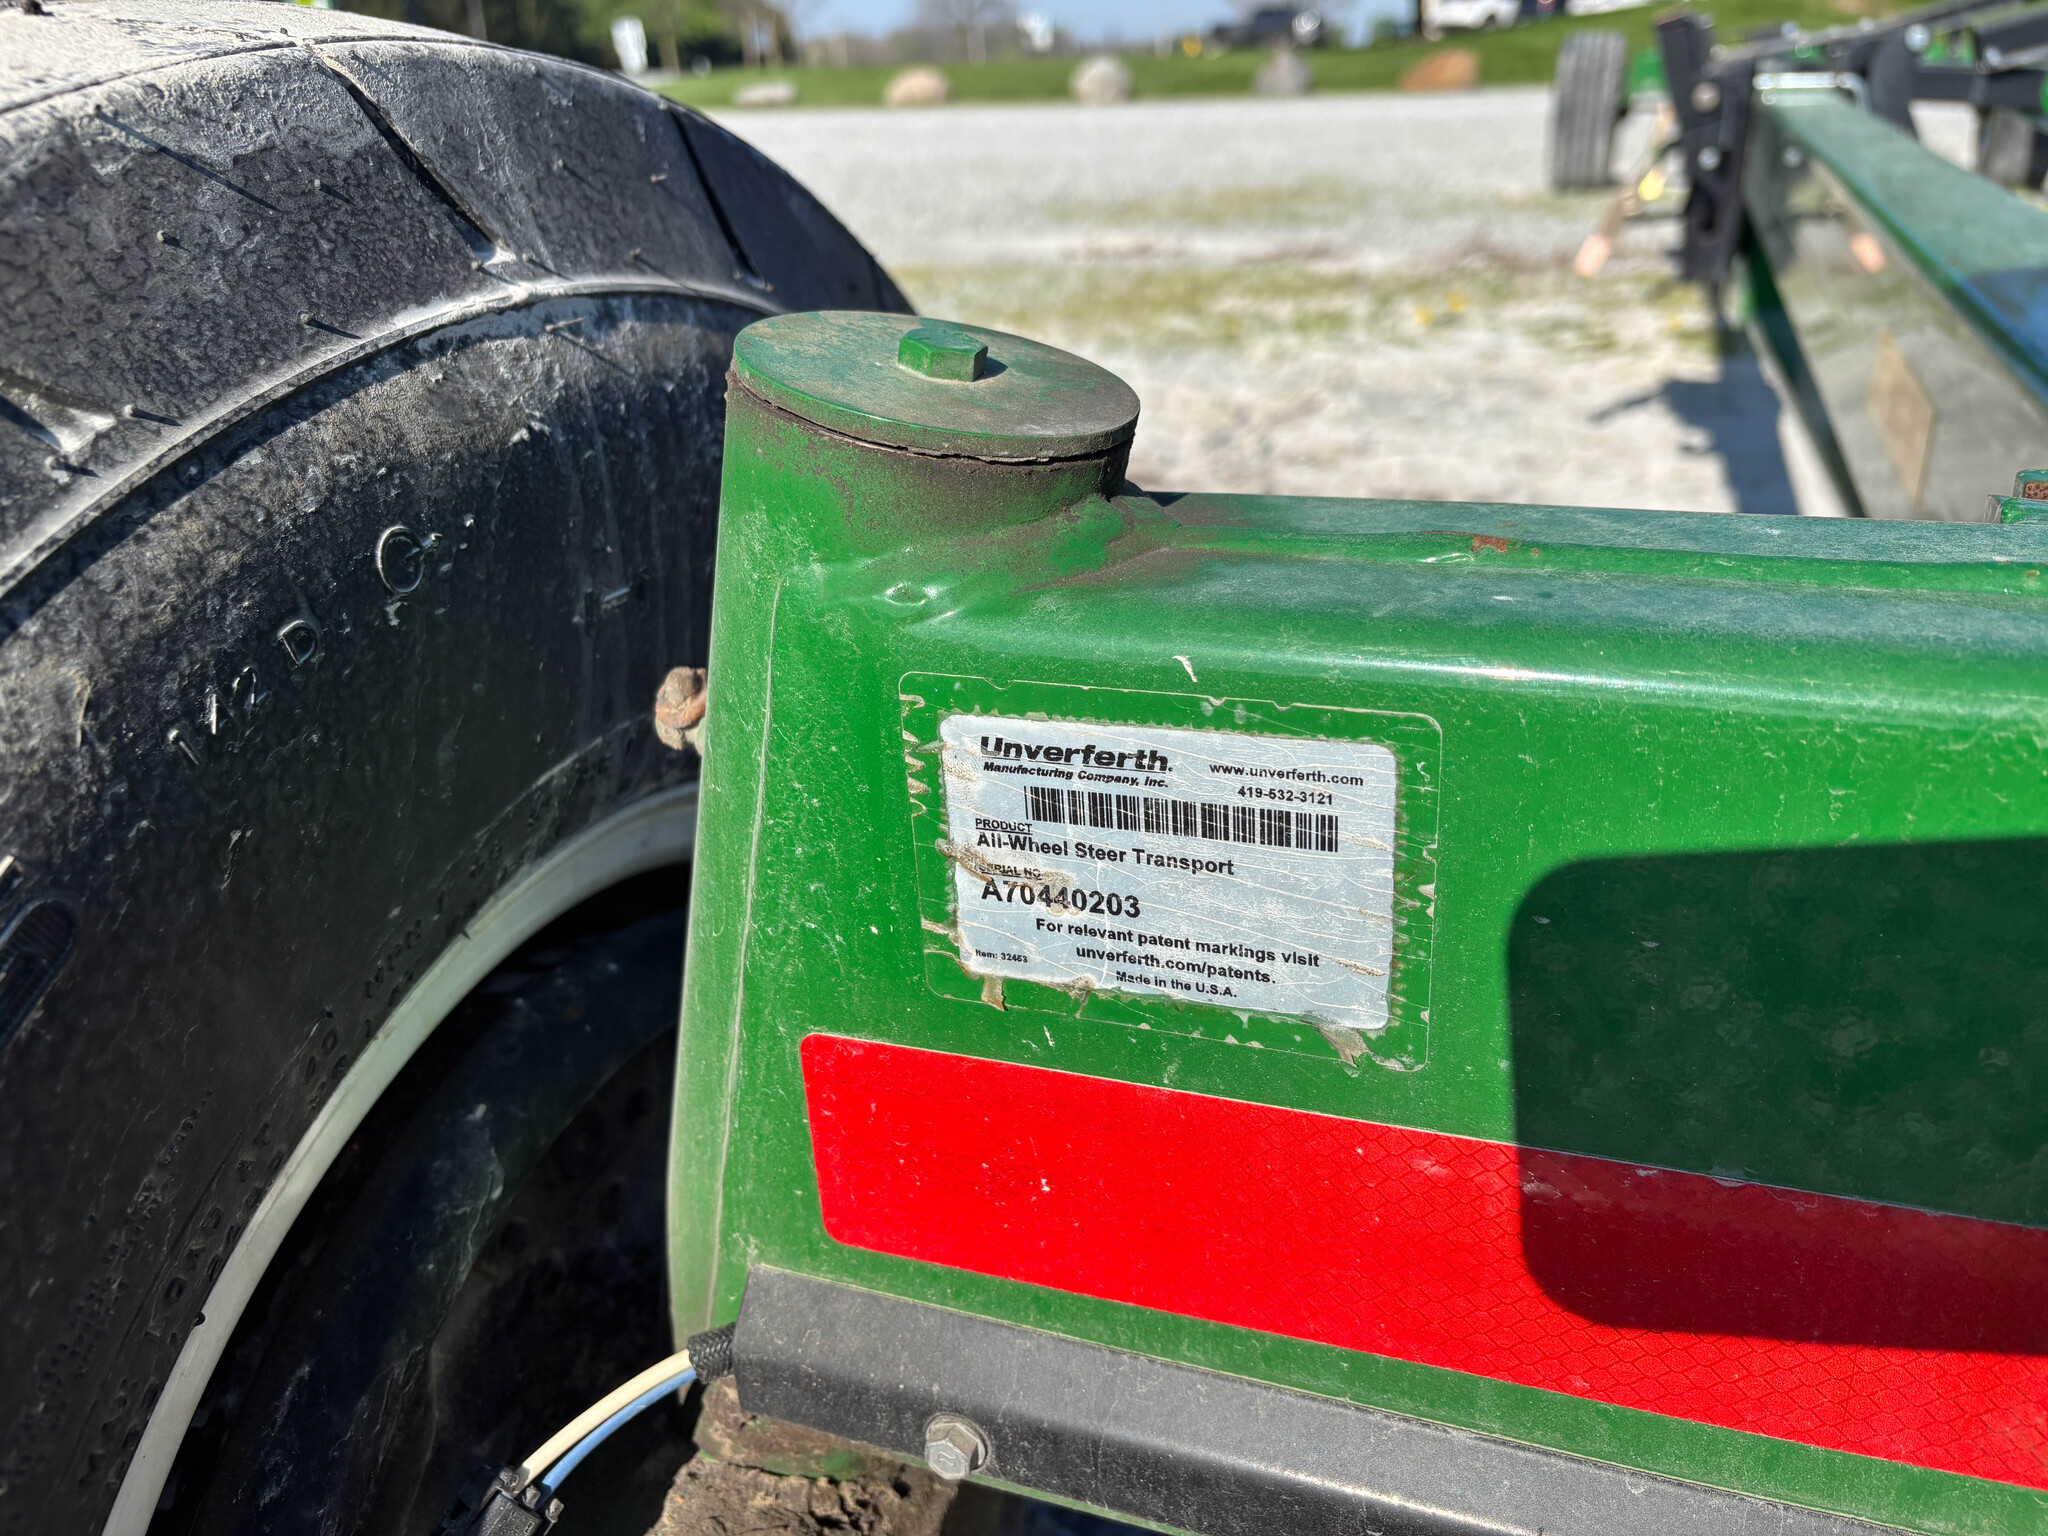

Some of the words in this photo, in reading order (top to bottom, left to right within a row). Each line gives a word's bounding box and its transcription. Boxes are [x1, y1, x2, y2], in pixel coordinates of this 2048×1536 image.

[983, 761, 1074, 780] Manufacturing
[1077, 770, 1139, 787] Company,
[1144, 776, 1169, 788] Inc.
[1209, 764, 1364, 786] www.unverferth.com
[1237, 785, 1333, 805] 419-532-3121
[975, 818, 1032, 833] PRODUCT
[976, 832, 1068, 857] All-Wheel
[1075, 842, 1127, 863] Steer
[1132, 848, 1235, 876] Transport
[981, 878, 1141, 919] A70440203
[975, 949, 998, 960] Item:
[1035, 918, 1063, 932] For
[1068, 924, 1134, 943] relevant
[1138, 932, 1191, 951] patent
[1195, 940, 1276, 963] markings
[1281, 951, 1320, 967] visit
[1076, 947, 1276, 984] unverferth.com/patents.
[1116, 971, 1151, 985] Made
[1154, 976, 1167, 988] in
[1171, 979, 1192, 991] the
[1195, 982, 1237, 998] U.S.A.
